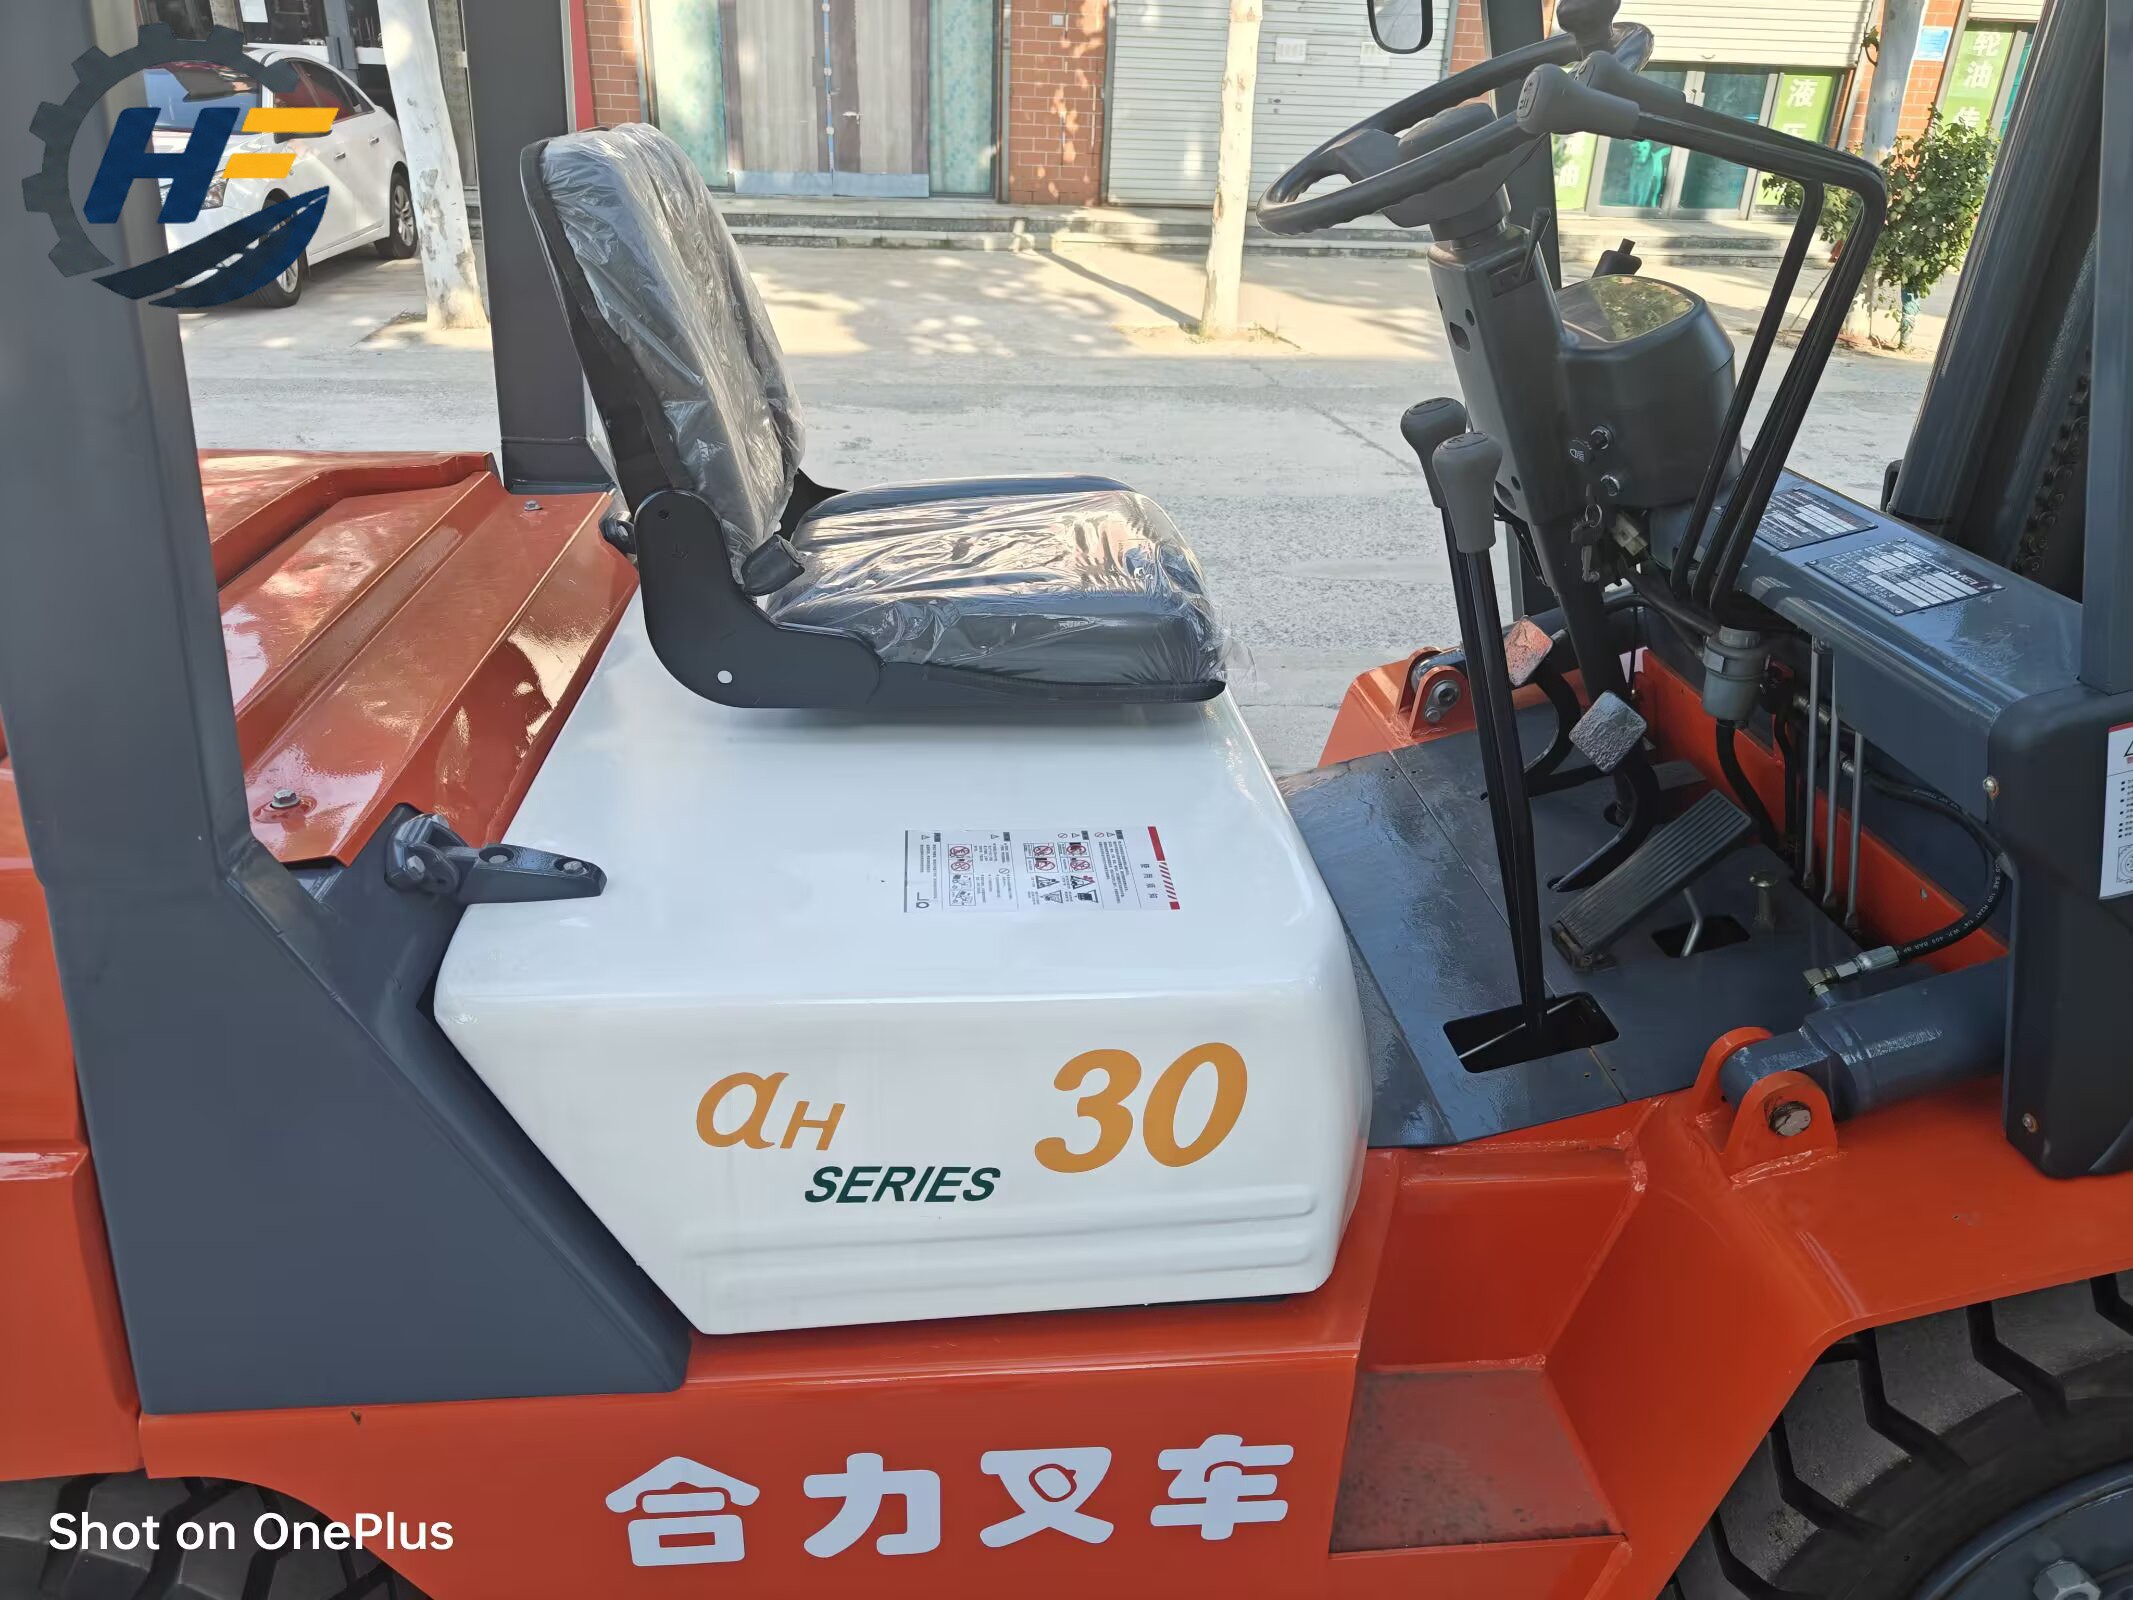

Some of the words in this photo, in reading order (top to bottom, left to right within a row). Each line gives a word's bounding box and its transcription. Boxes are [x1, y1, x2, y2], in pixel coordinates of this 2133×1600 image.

[1034, 1042, 1248, 1173] 30
[804, 1166, 1001, 1203] SERIES
[605, 1433, 1294, 1566] 合力叉车
